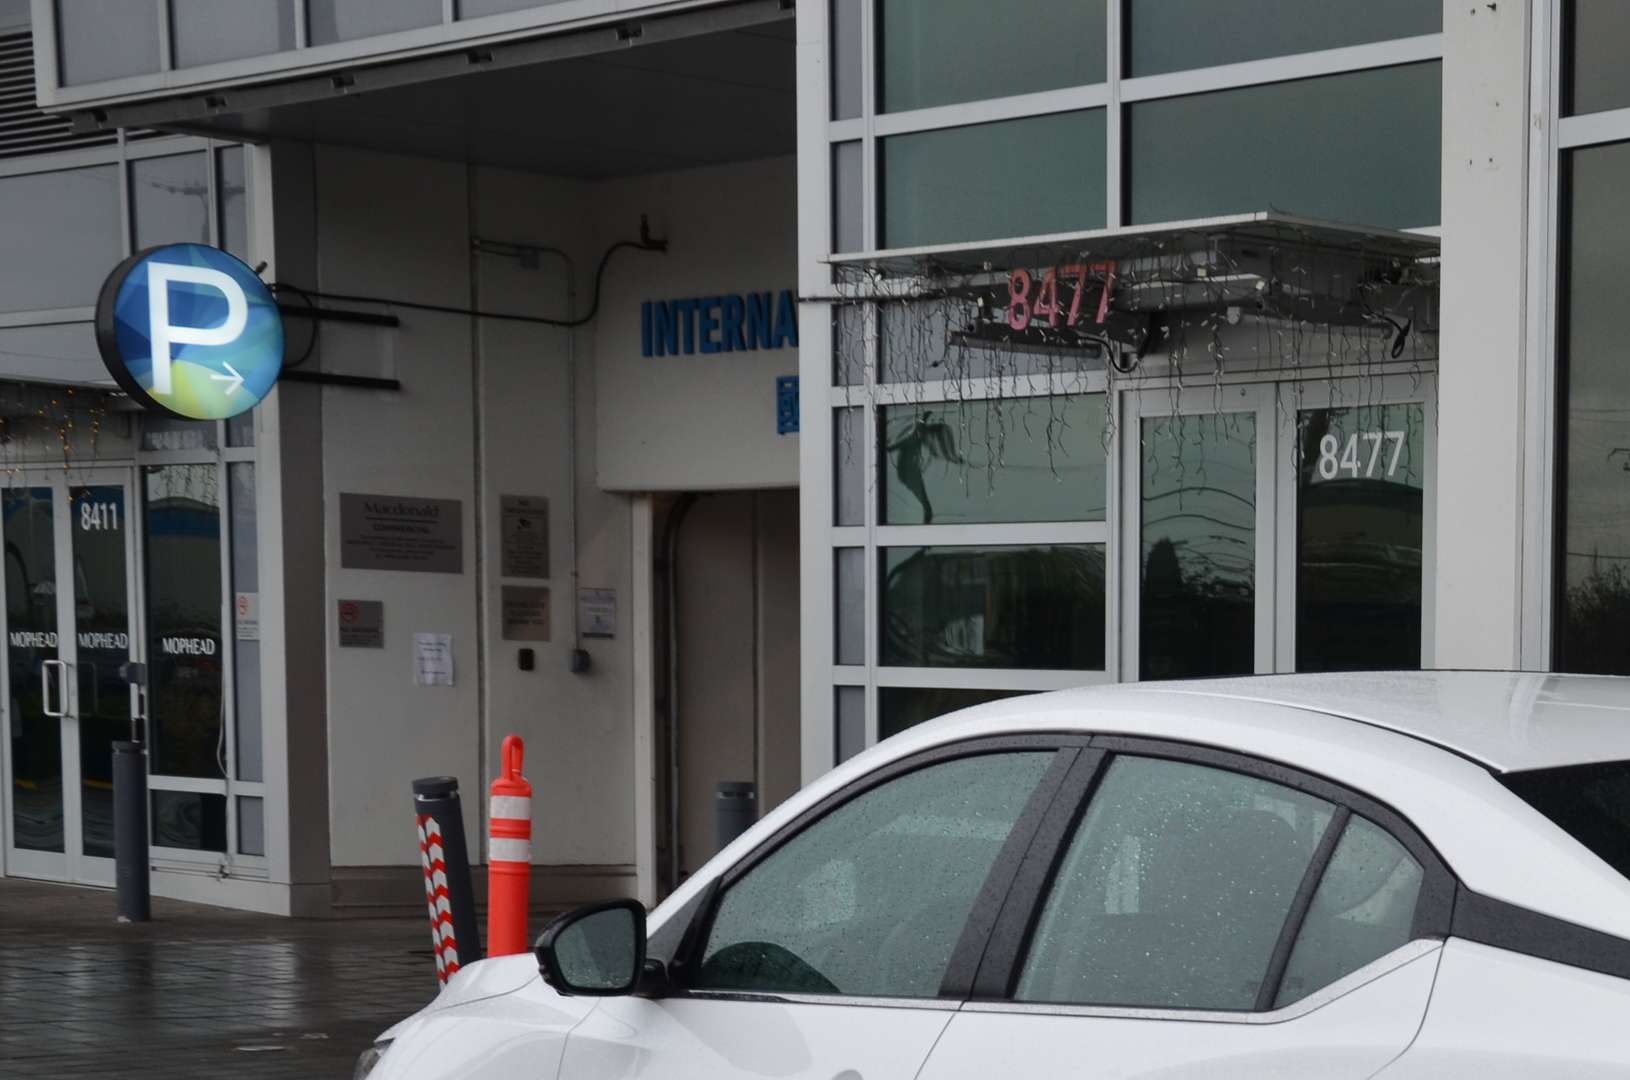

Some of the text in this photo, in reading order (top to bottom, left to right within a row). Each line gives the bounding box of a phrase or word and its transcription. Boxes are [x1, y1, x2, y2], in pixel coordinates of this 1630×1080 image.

[1008, 260, 1119, 330] 8477
[147, 261, 249, 396] P
[1319, 431, 1405, 480] 8477
[81, 502, 118, 531] 8411
[9, 631, 129, 650] MOPHEAD MOPHEAD
[162, 638, 216, 656] MOPHEAD
